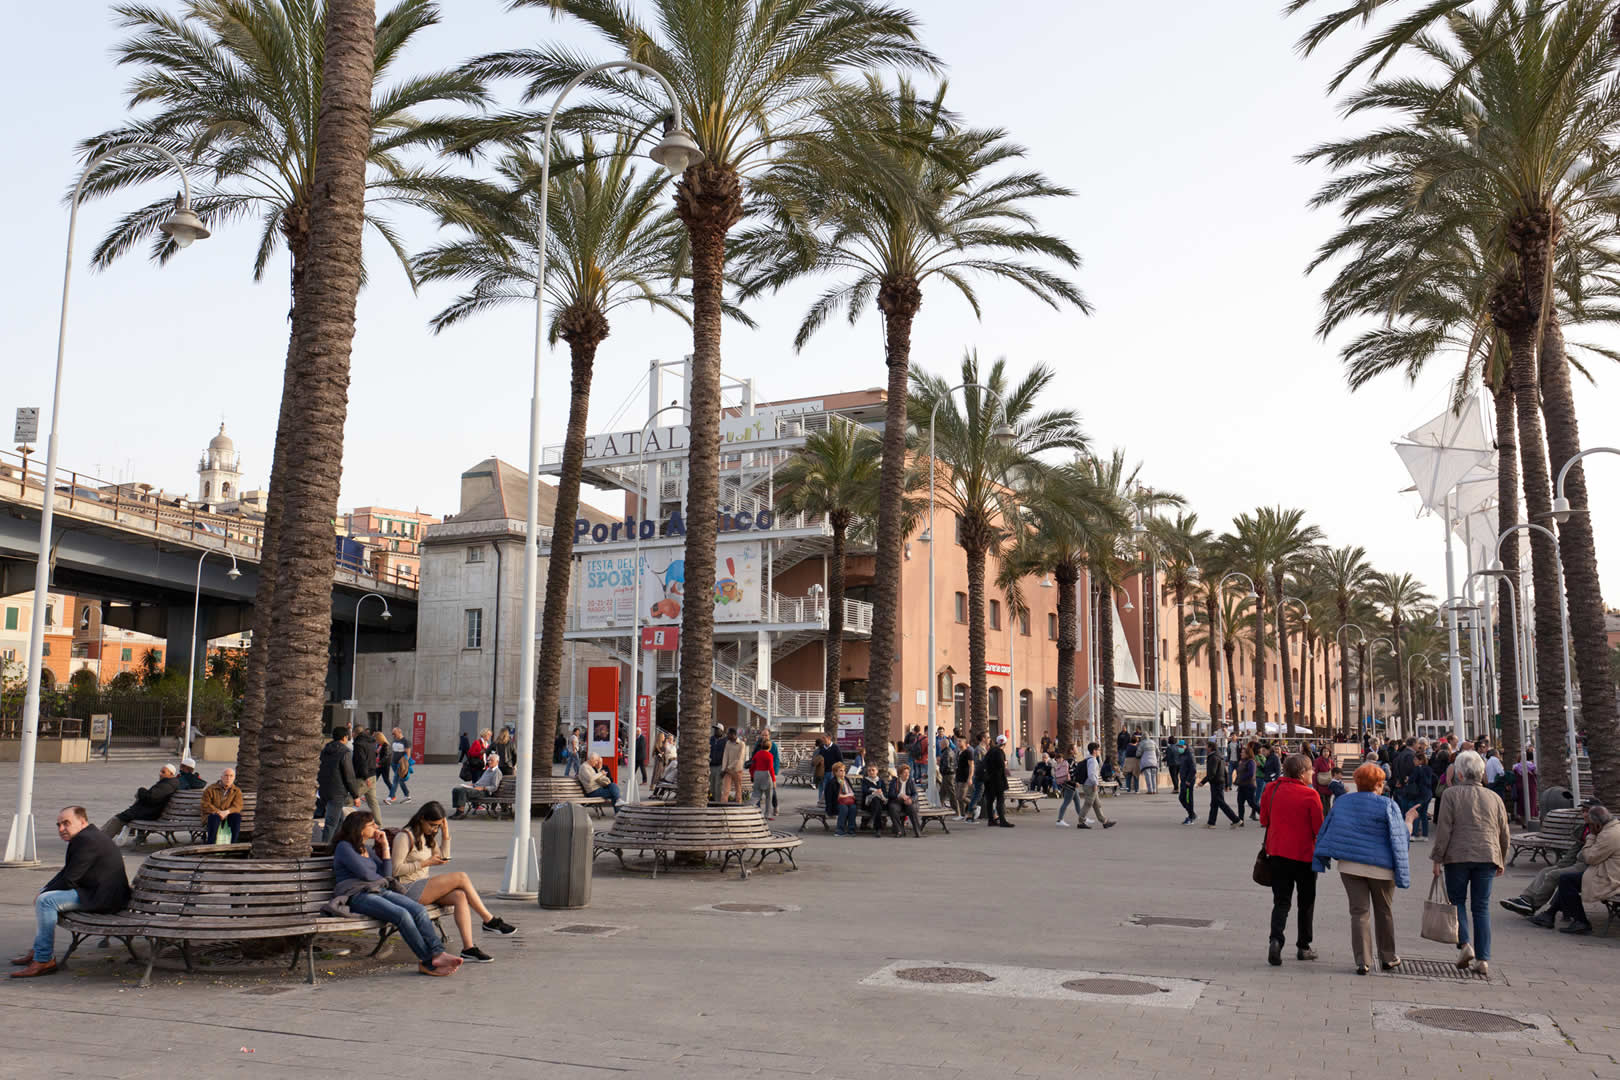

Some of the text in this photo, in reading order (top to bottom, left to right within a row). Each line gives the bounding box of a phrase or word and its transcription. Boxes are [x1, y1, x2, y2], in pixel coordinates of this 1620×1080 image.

[584, 425, 692, 458] EATAL
[573, 505, 774, 544] Porto Aico
[617, 556, 644, 569] DELO
